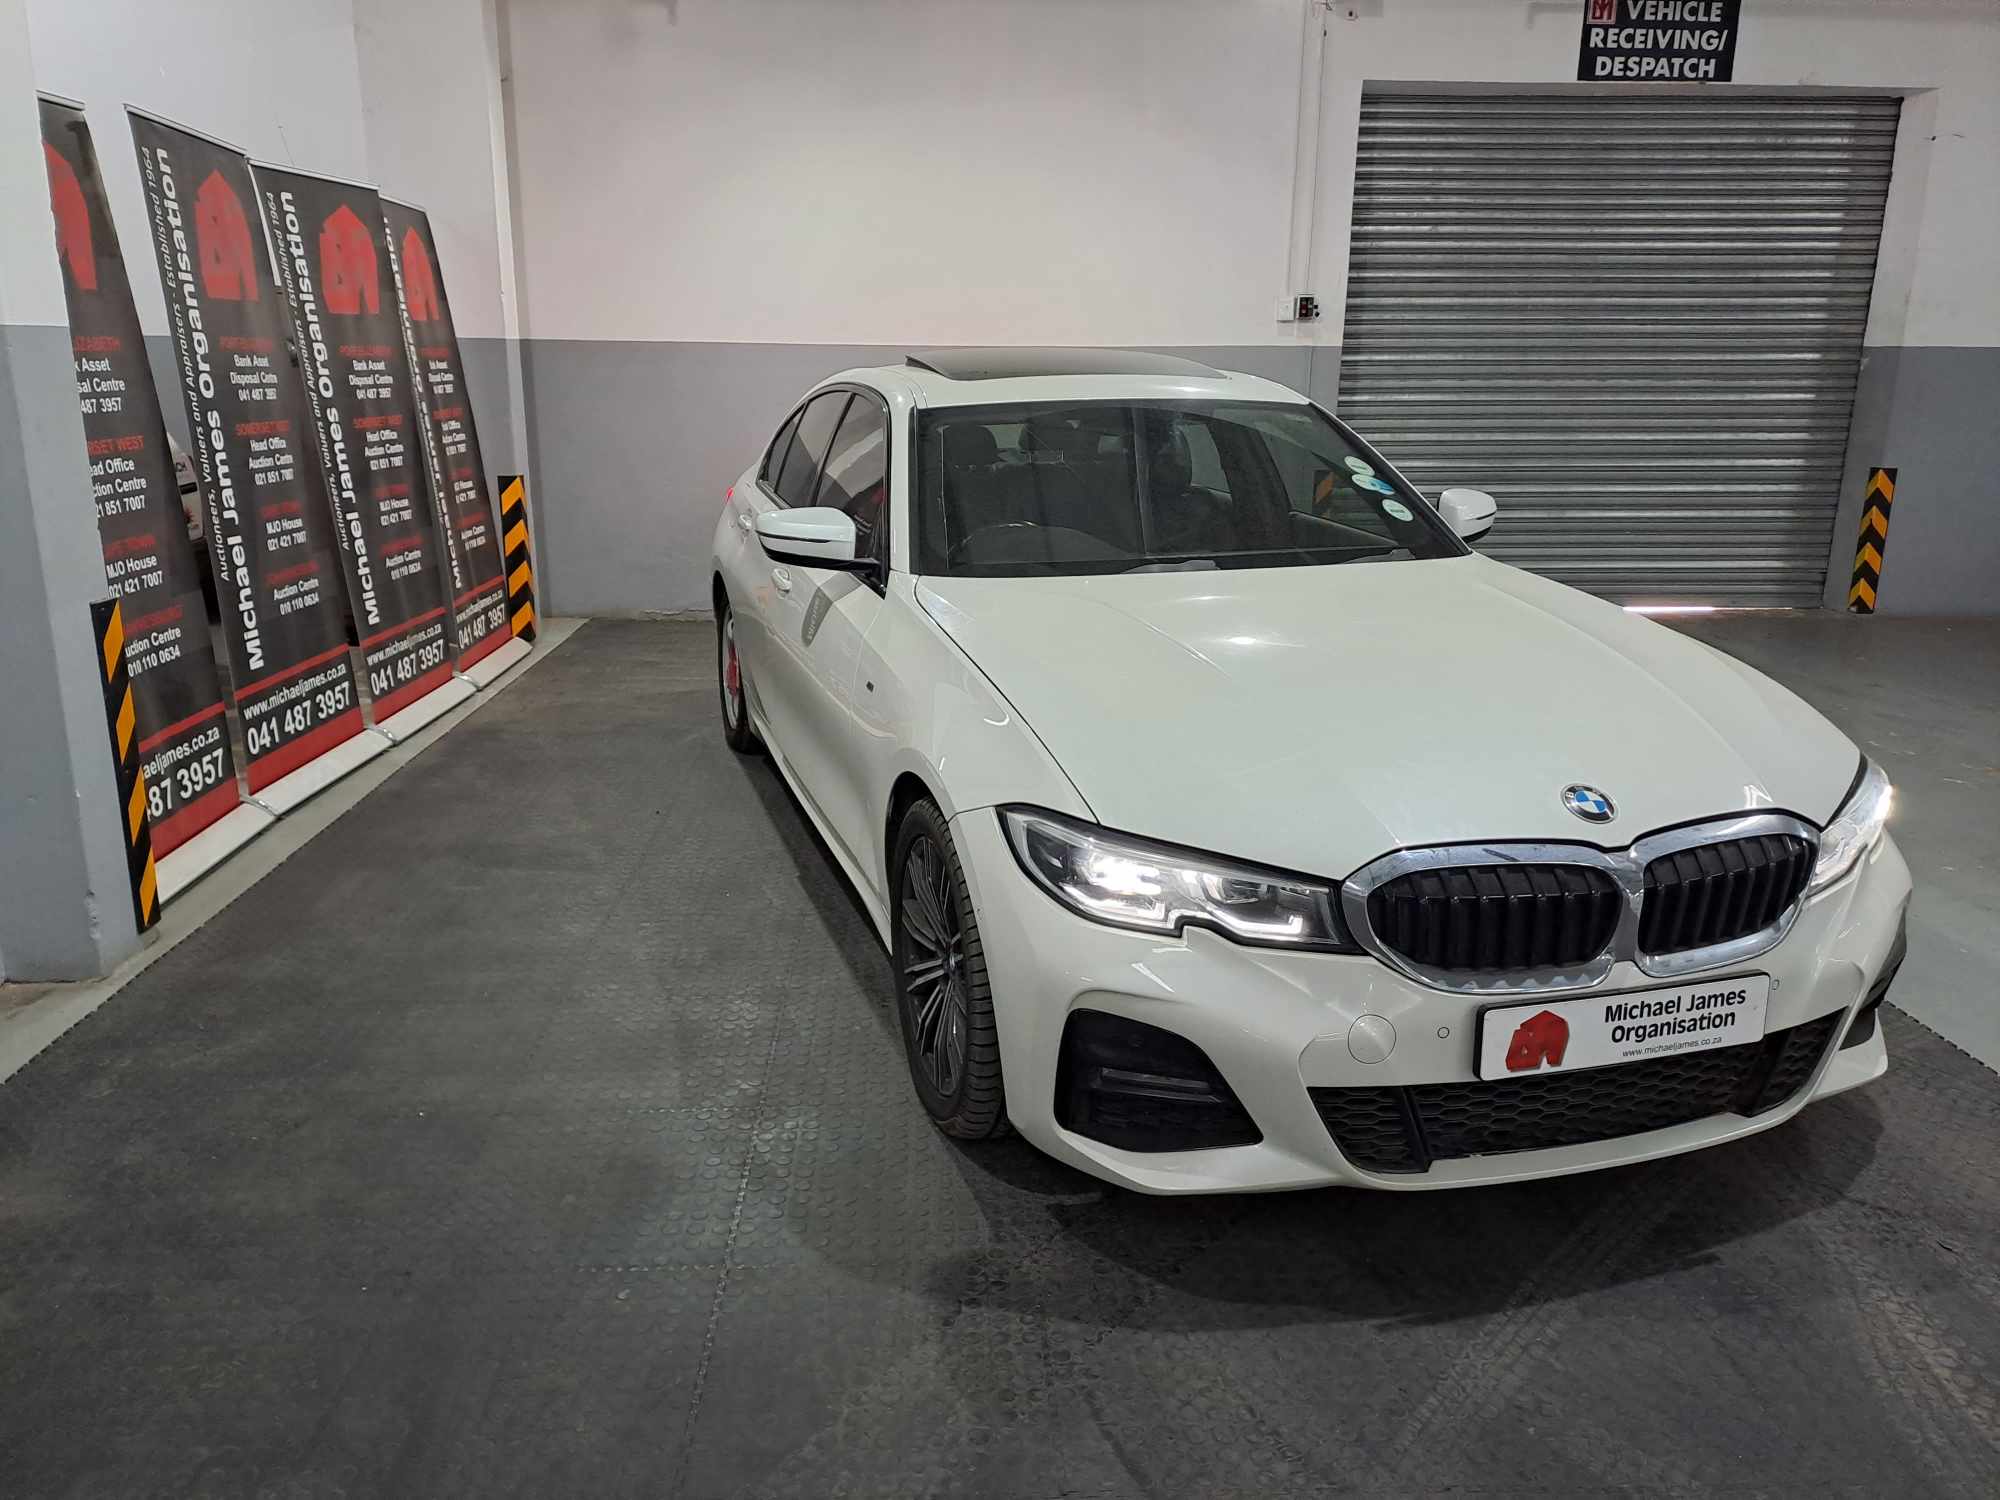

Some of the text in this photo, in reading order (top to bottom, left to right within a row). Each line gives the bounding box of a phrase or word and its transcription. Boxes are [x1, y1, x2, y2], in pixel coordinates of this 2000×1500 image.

[1627, 0, 1724, 23] VEHICLE
[1589, 28, 1729, 51] RECEIVING/
[1595, 56, 1716, 78] DESPATCH
[150, 191, 176, 288] Established
[274, 228, 298, 307] Established
[280, 191, 333, 398] Organisation
[173, 303, 196, 386] Appraisers
[82, 357, 111, 372] Asset
[93, 377, 126, 392] Centre
[100, 397, 122, 413] 3957
[156, 148, 264, 671] Michael James Organisation
[187, 390, 201, 422] and
[88, 457, 135, 476] ead Office
[326, 407, 356, 503] James
[115, 476, 147, 493] Centre
[96, 495, 146, 518] 21 851 7007
[106, 554, 157, 579] MJO House
[124, 578, 140, 594] 421
[141, 571, 163, 588] 7007
[346, 511, 380, 625] Michael
[125, 626, 181, 658] uction Centre
[458, 603, 505, 649] 041 487 3957
[159, 645, 181, 664] 0634
[370, 638, 444, 695] 041 487 3957
[243, 663, 347, 720] www.michaeljames.co.za
[247, 681, 350, 755] 041 487 3957
[143, 726, 220, 779] aeljames.co.za
[177, 747, 224, 799] 3957
[1604, 989, 1747, 1023] Michael James
[1611, 1010, 1736, 1045] Organisation
[1622, 1035, 1723, 1057] www.michaeljames.co.za
